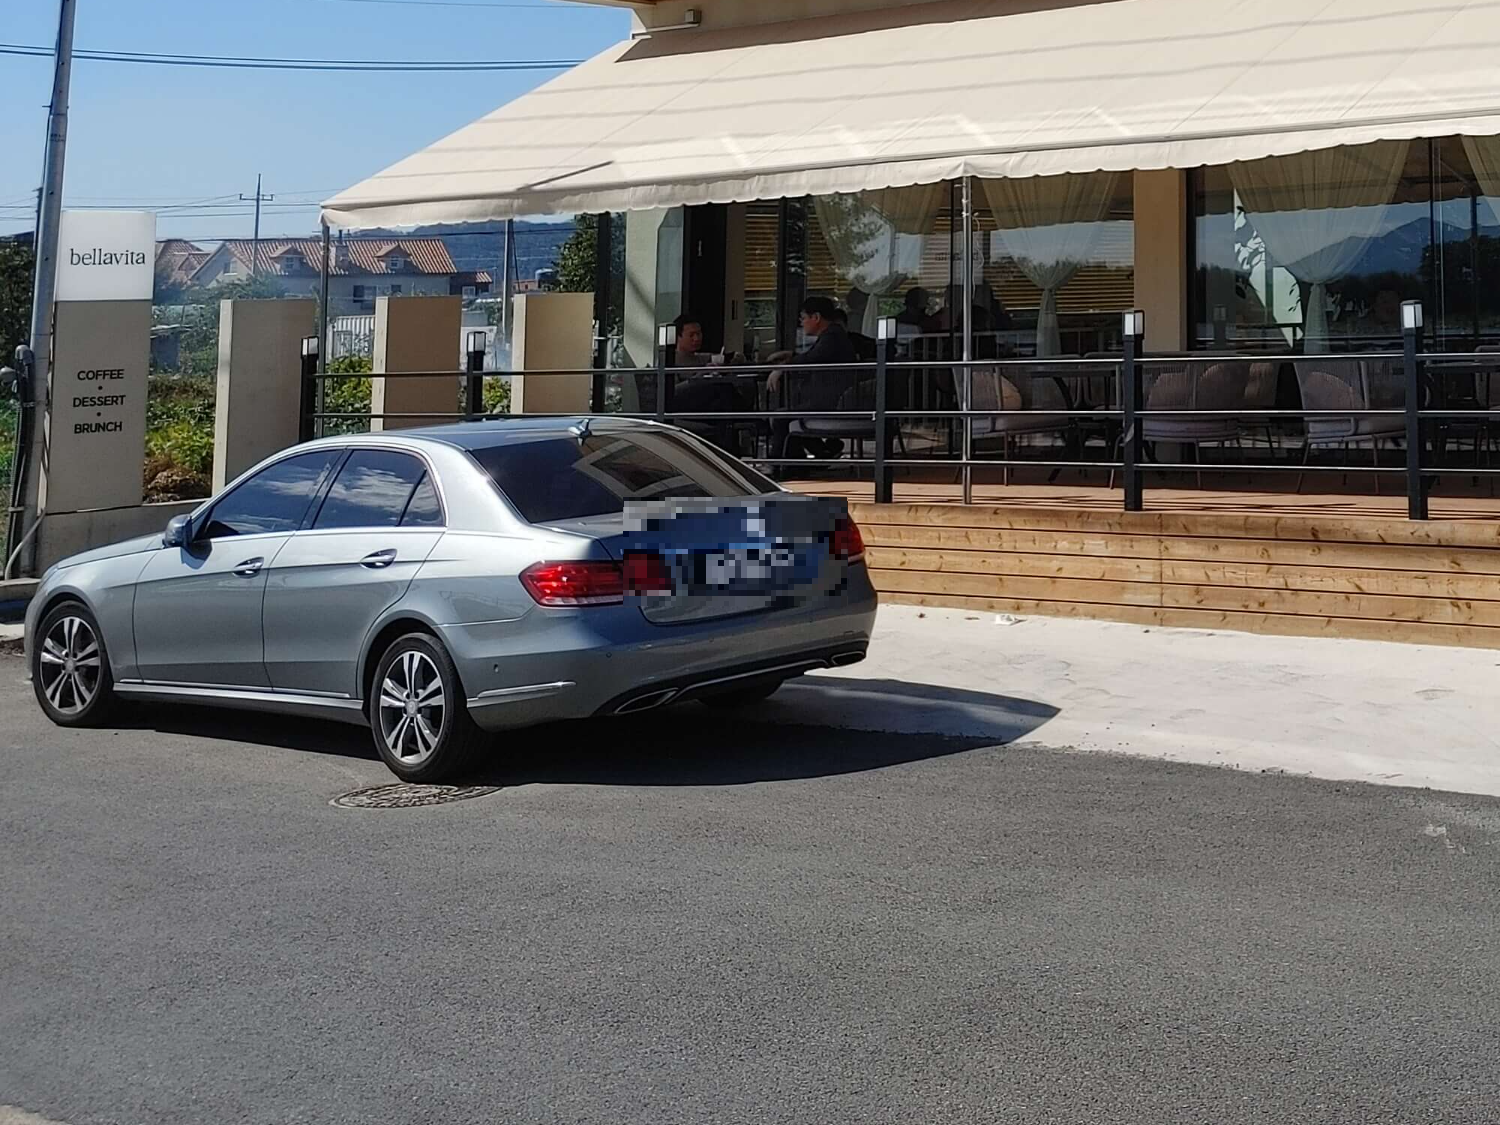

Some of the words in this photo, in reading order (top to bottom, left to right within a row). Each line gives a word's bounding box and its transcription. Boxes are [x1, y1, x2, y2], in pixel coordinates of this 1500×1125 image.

[70, 248, 146, 266] bellavita
[77, 369, 125, 381] COFFEE
[72, 394, 127, 408] DESSERT
[74, 420, 123, 434] BRUNCH
